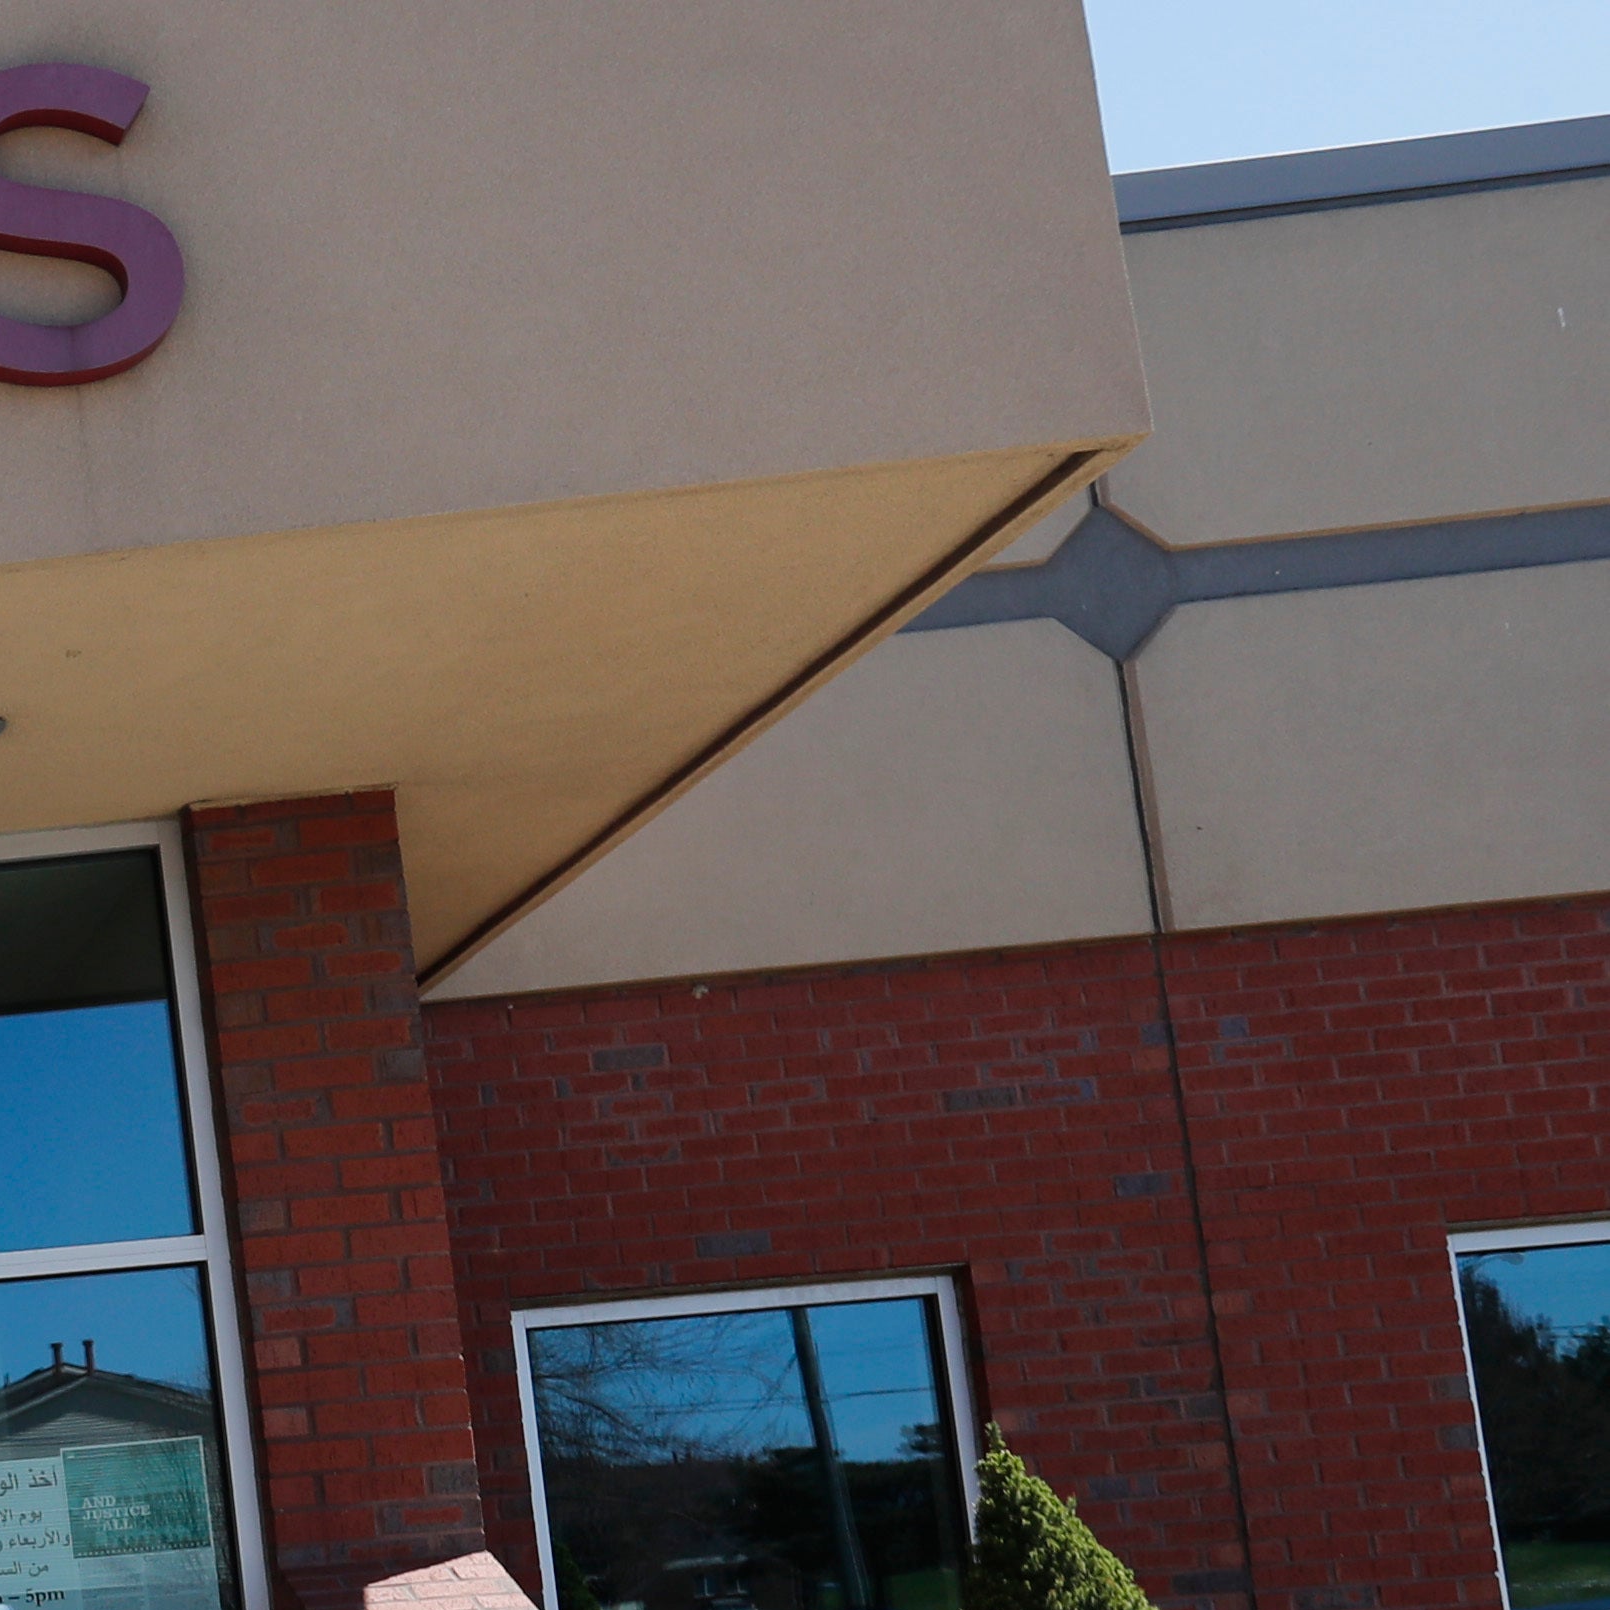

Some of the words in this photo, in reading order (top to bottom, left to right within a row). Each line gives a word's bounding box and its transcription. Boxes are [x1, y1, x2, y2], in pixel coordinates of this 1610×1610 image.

[82, 1495, 116, 1509] AND
[82, 1504, 151, 1520] JUSTICE
[25, 1588, 65, 1607] 5pm
